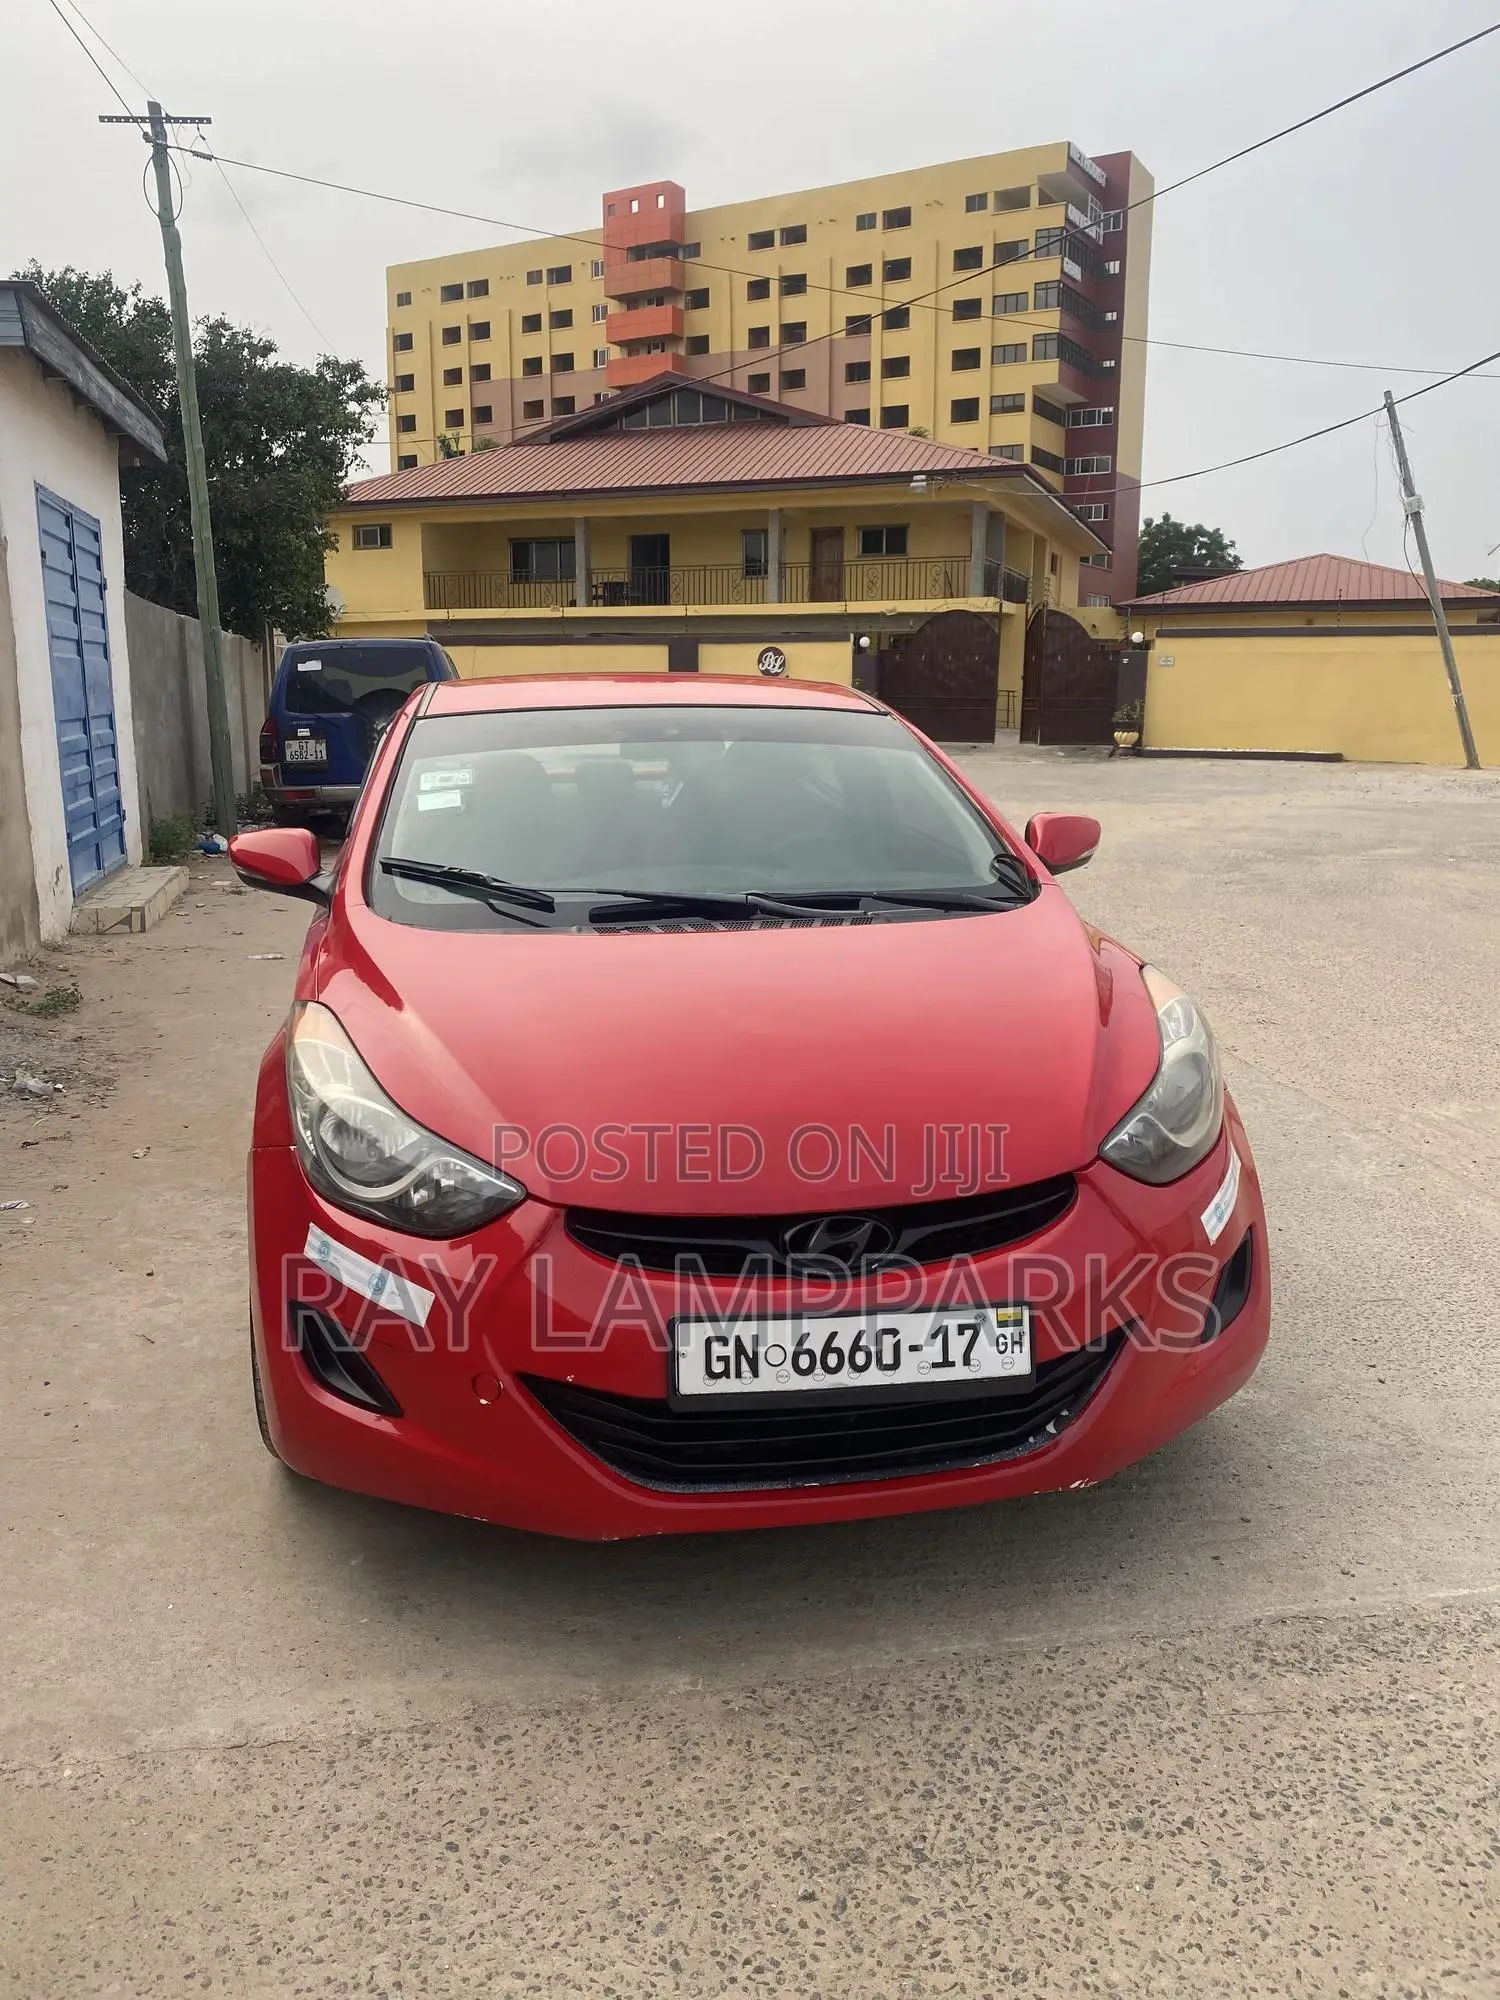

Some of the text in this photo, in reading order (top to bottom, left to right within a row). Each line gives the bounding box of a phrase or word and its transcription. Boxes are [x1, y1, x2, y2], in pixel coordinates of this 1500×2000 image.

[298, 741, 309, 751] GT
[289, 750, 324, 760] 6582-11
[995, 1331, 1023, 1355] GH
[704, 1333, 760, 1380] GN
